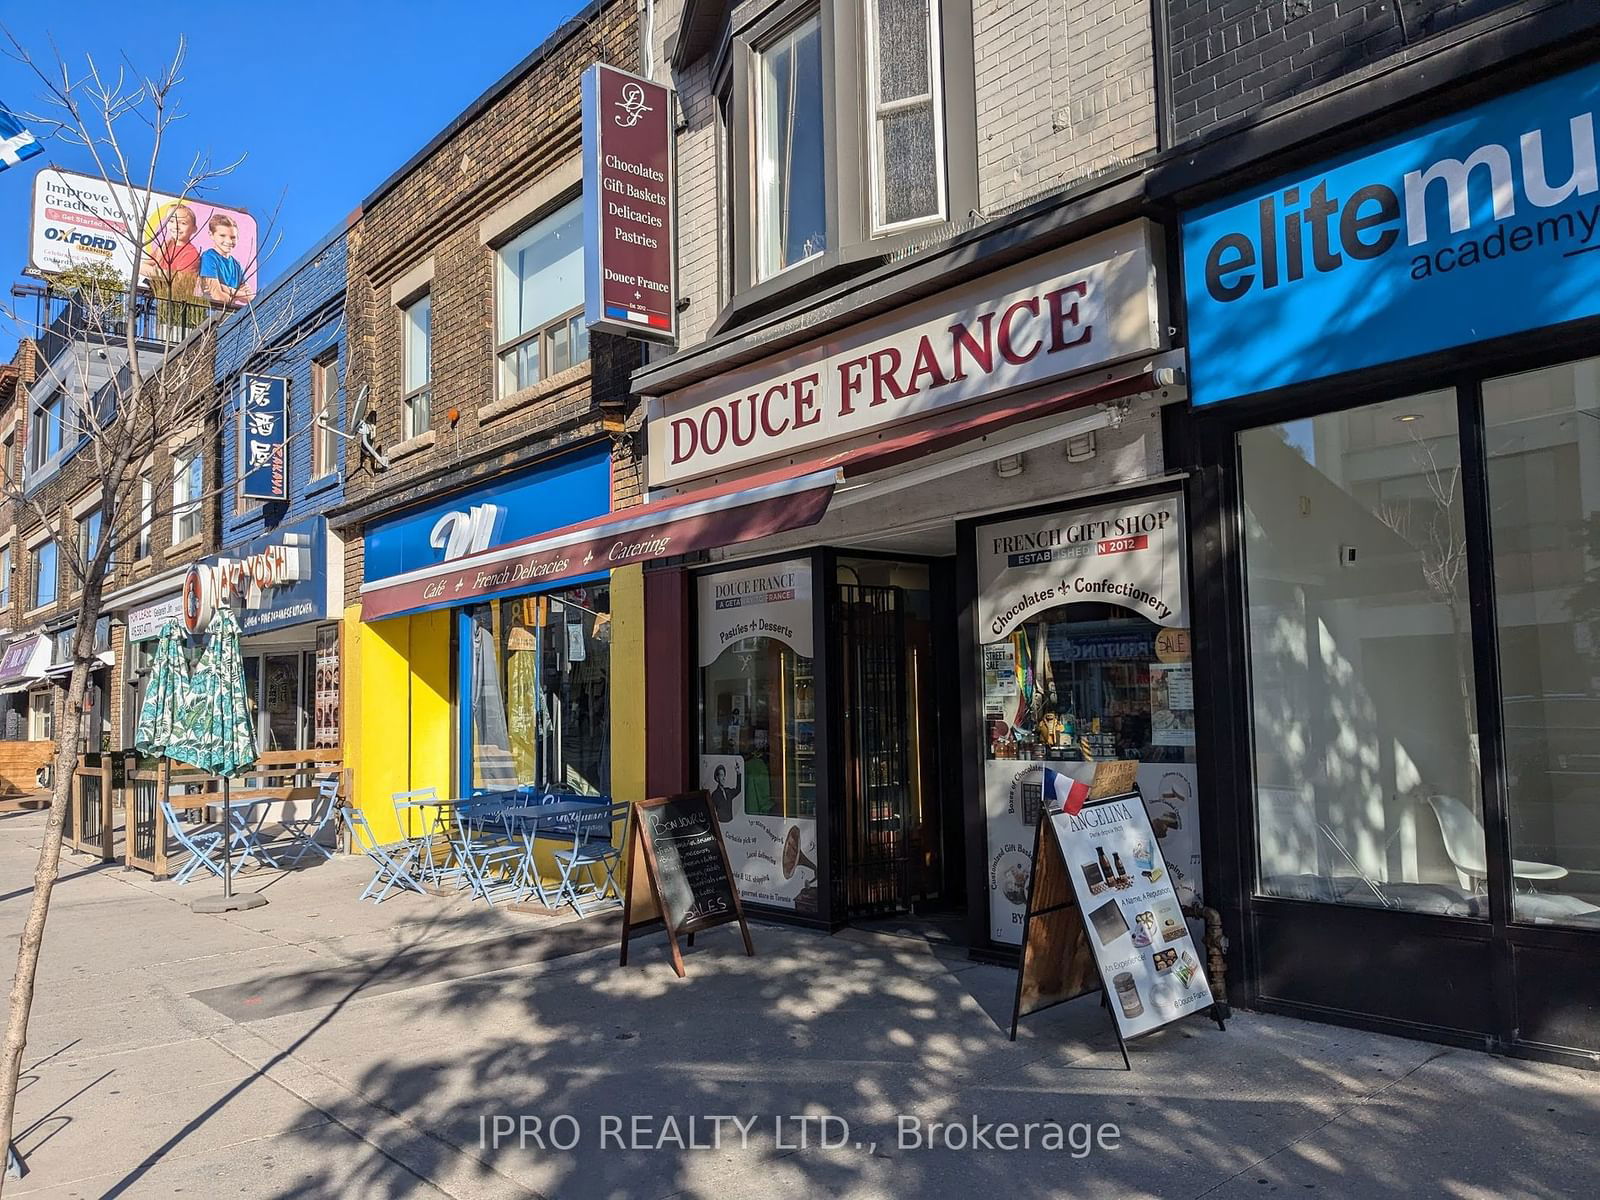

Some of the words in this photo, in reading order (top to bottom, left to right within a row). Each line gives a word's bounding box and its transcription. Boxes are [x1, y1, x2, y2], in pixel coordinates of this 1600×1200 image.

[605, 154, 664, 182] Chocolates
[46, 181, 109, 204] Improve
[603, 177, 625, 195] Gift
[626, 183, 667, 206] Baskets
[45, 194, 99, 214] Grades
[103, 206, 135, 222] Now
[608, 201, 663, 228] Delicacies
[44, 227, 117, 251] OXFORD
[78, 245, 113, 257] LEARNING
[615, 227, 658, 249] Pastries
[1410, 205, 1600, 281] academy
[604, 268, 636, 286] Douce
[637, 275, 669, 293] France
[670, 373, 823, 466] DOUCE
[837, 281, 1094, 417] FRANCE
[993, 528, 1061, 554] FRENCH
[1066, 520, 1110, 544] GIFT
[1113, 511, 1170, 536] SHOP
[1018, 546, 1090, 564] ESTABLISHED
[1094, 542, 1106, 554] IN
[1109, 538, 1135, 552] 2012
[423, 579, 447, 600] Café
[472, 570, 510, 591] French
[511, 555, 571, 583] Delicacies
[607, 534, 671, 562] Catering
[715, 580, 751, 599] DOUCE
[753, 573, 795, 593] FRANCE
[991, 586, 1055, 635] Chocolates
[1074, 577, 1173, 620] Confectionery
[719, 623, 749, 644] Pastries
[758, 618, 793, 639] Desserts
[1158, 634, 1185, 653] SALE
[985, 651, 1006, 661] STREET
[986, 661, 1000, 670] SALE
[1007, 790, 1015, 815] Boxes
[1011, 780, 1017, 790] of
[1069, 803, 1133, 832] ANGELINA
[991, 848, 1005, 890] Customized
[1004, 844, 1016, 853] Gift
[683, 896, 728, 920] SALES
